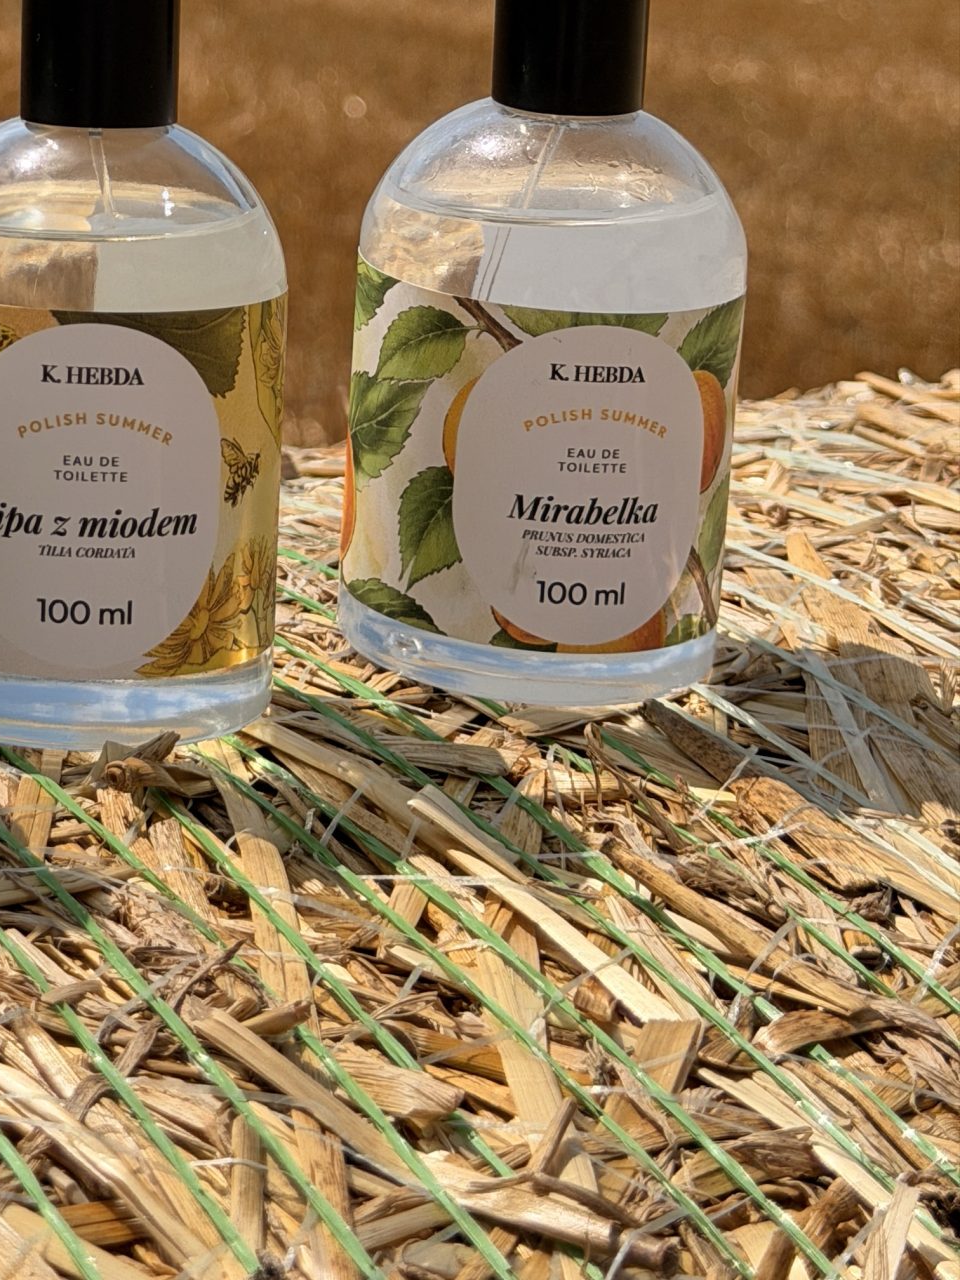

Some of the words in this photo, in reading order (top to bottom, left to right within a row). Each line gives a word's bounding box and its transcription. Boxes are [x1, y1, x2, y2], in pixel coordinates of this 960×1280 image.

[41, 364, 61, 384] K.
[66, 367, 144, 386] HEBDA
[549, 363, 569, 381] K.
[574, 365, 646, 383] HEBDA
[17, 412, 87, 439] POLISH
[96, 413, 173, 446] SUMMER
[524, 408, 592, 432] POLISH
[601, 409, 667, 439] SUMMER
[63, 455, 93, 467] EAU
[100, 456, 120, 467] DE
[567, 448, 596, 459] EAU
[602, 449, 620, 459] DE
[54, 470, 128, 483] TOILETTE
[558, 462, 627, 473] TOILETTE
[506, 494, 659, 525] Mirabelka
[50, 516, 71, 537] z
[79, 507, 198, 539] miodem
[522, 529, 574, 543] PRUNUS
[576, 532, 645, 544] DOMESTICA
[39, 544, 72, 557] TILIA
[76, 546, 136, 559] CORDATA
[536, 545, 578, 557] SUBSP.
[581, 547, 632, 558] SYRIACA
[536, 580, 587, 605] 100
[595, 582, 626, 606] ml
[36, 599, 90, 624] 100
[99, 600, 133, 625] ml
